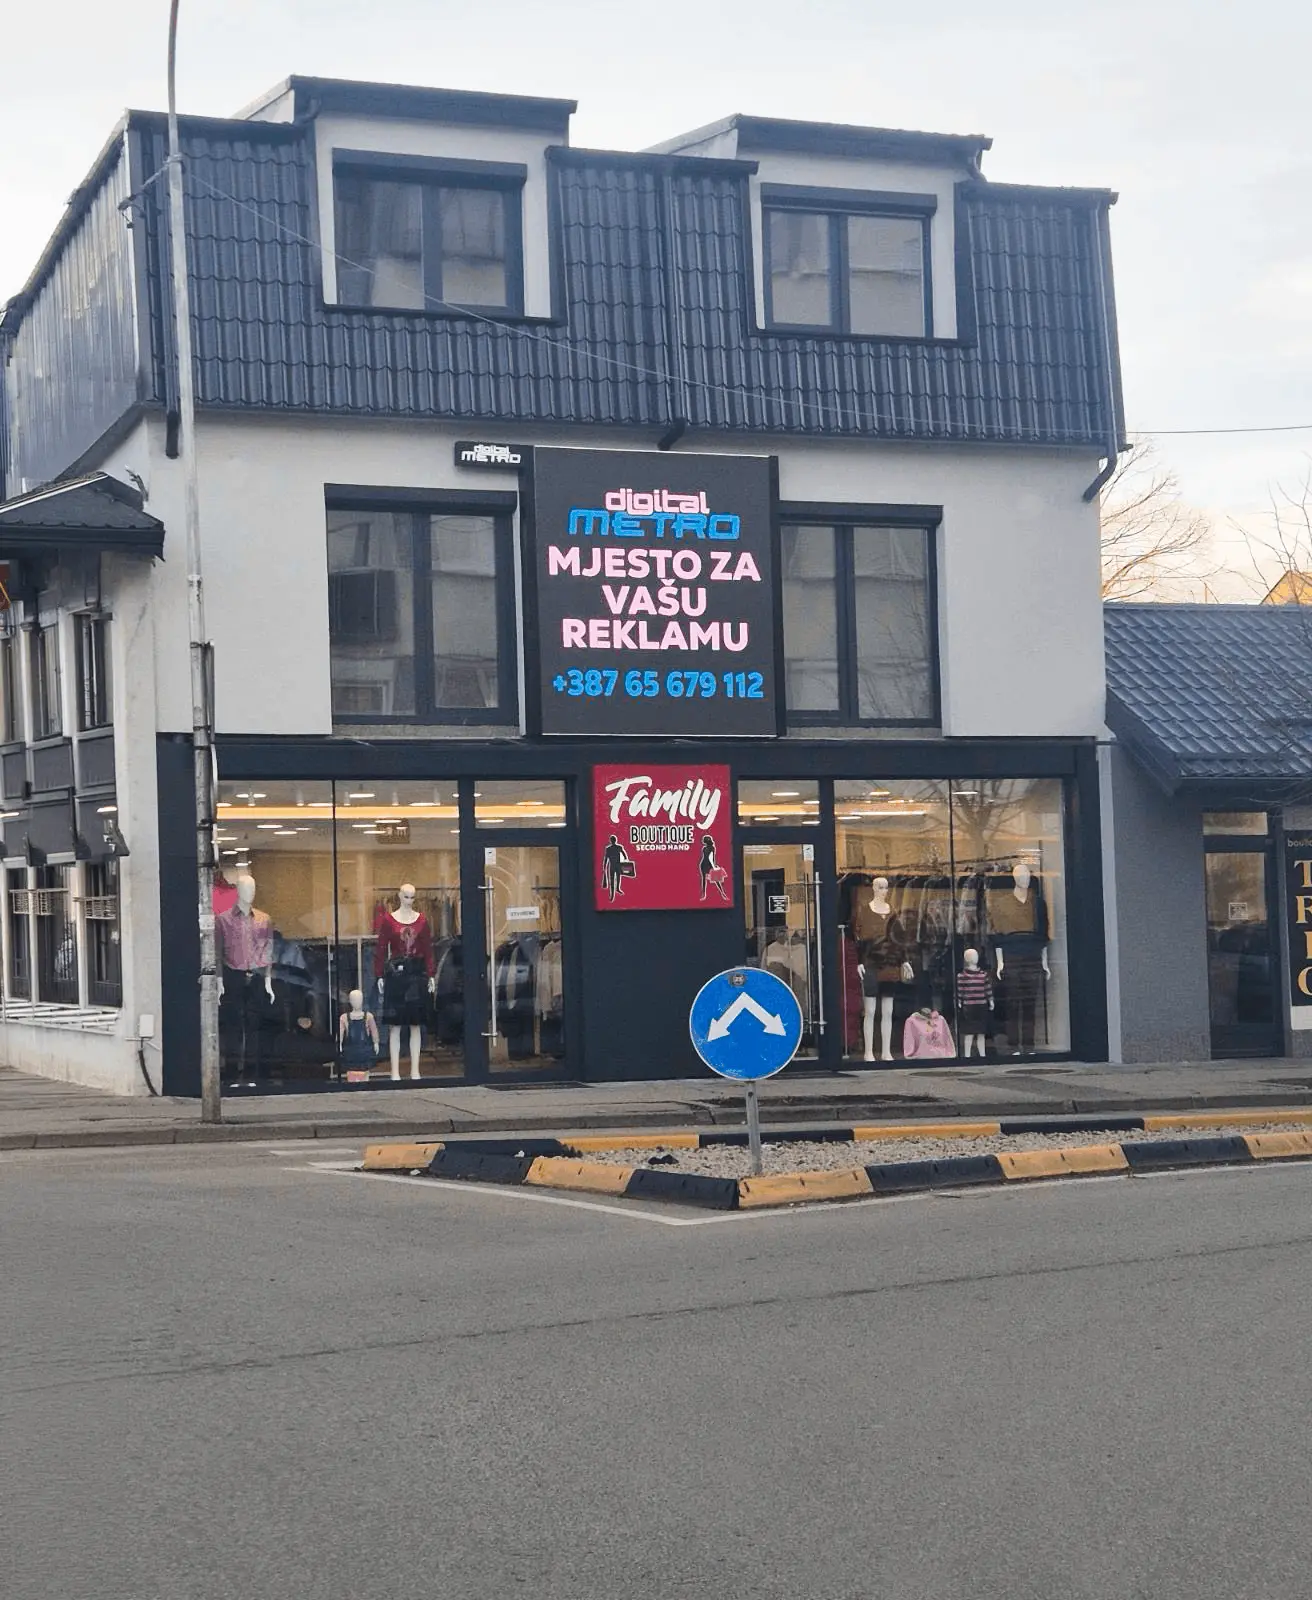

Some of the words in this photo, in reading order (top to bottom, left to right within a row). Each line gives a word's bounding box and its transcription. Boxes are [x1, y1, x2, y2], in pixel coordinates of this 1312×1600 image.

[605, 488, 710, 515] digital
[567, 506, 741, 541] METRO
[549, 546, 702, 578] MJESTO
[710, 552, 762, 581] ZA
[602, 579, 707, 617] VAŠU
[562, 619, 749, 652] REKLAMU
[552, 668, 618, 698] +387
[624, 670, 660, 698] 65
[666, 671, 718, 699] 679
[723, 672, 764, 699] 112
[605, 776, 721, 830] Family
[630, 825, 694, 844] BOUTIQUE
